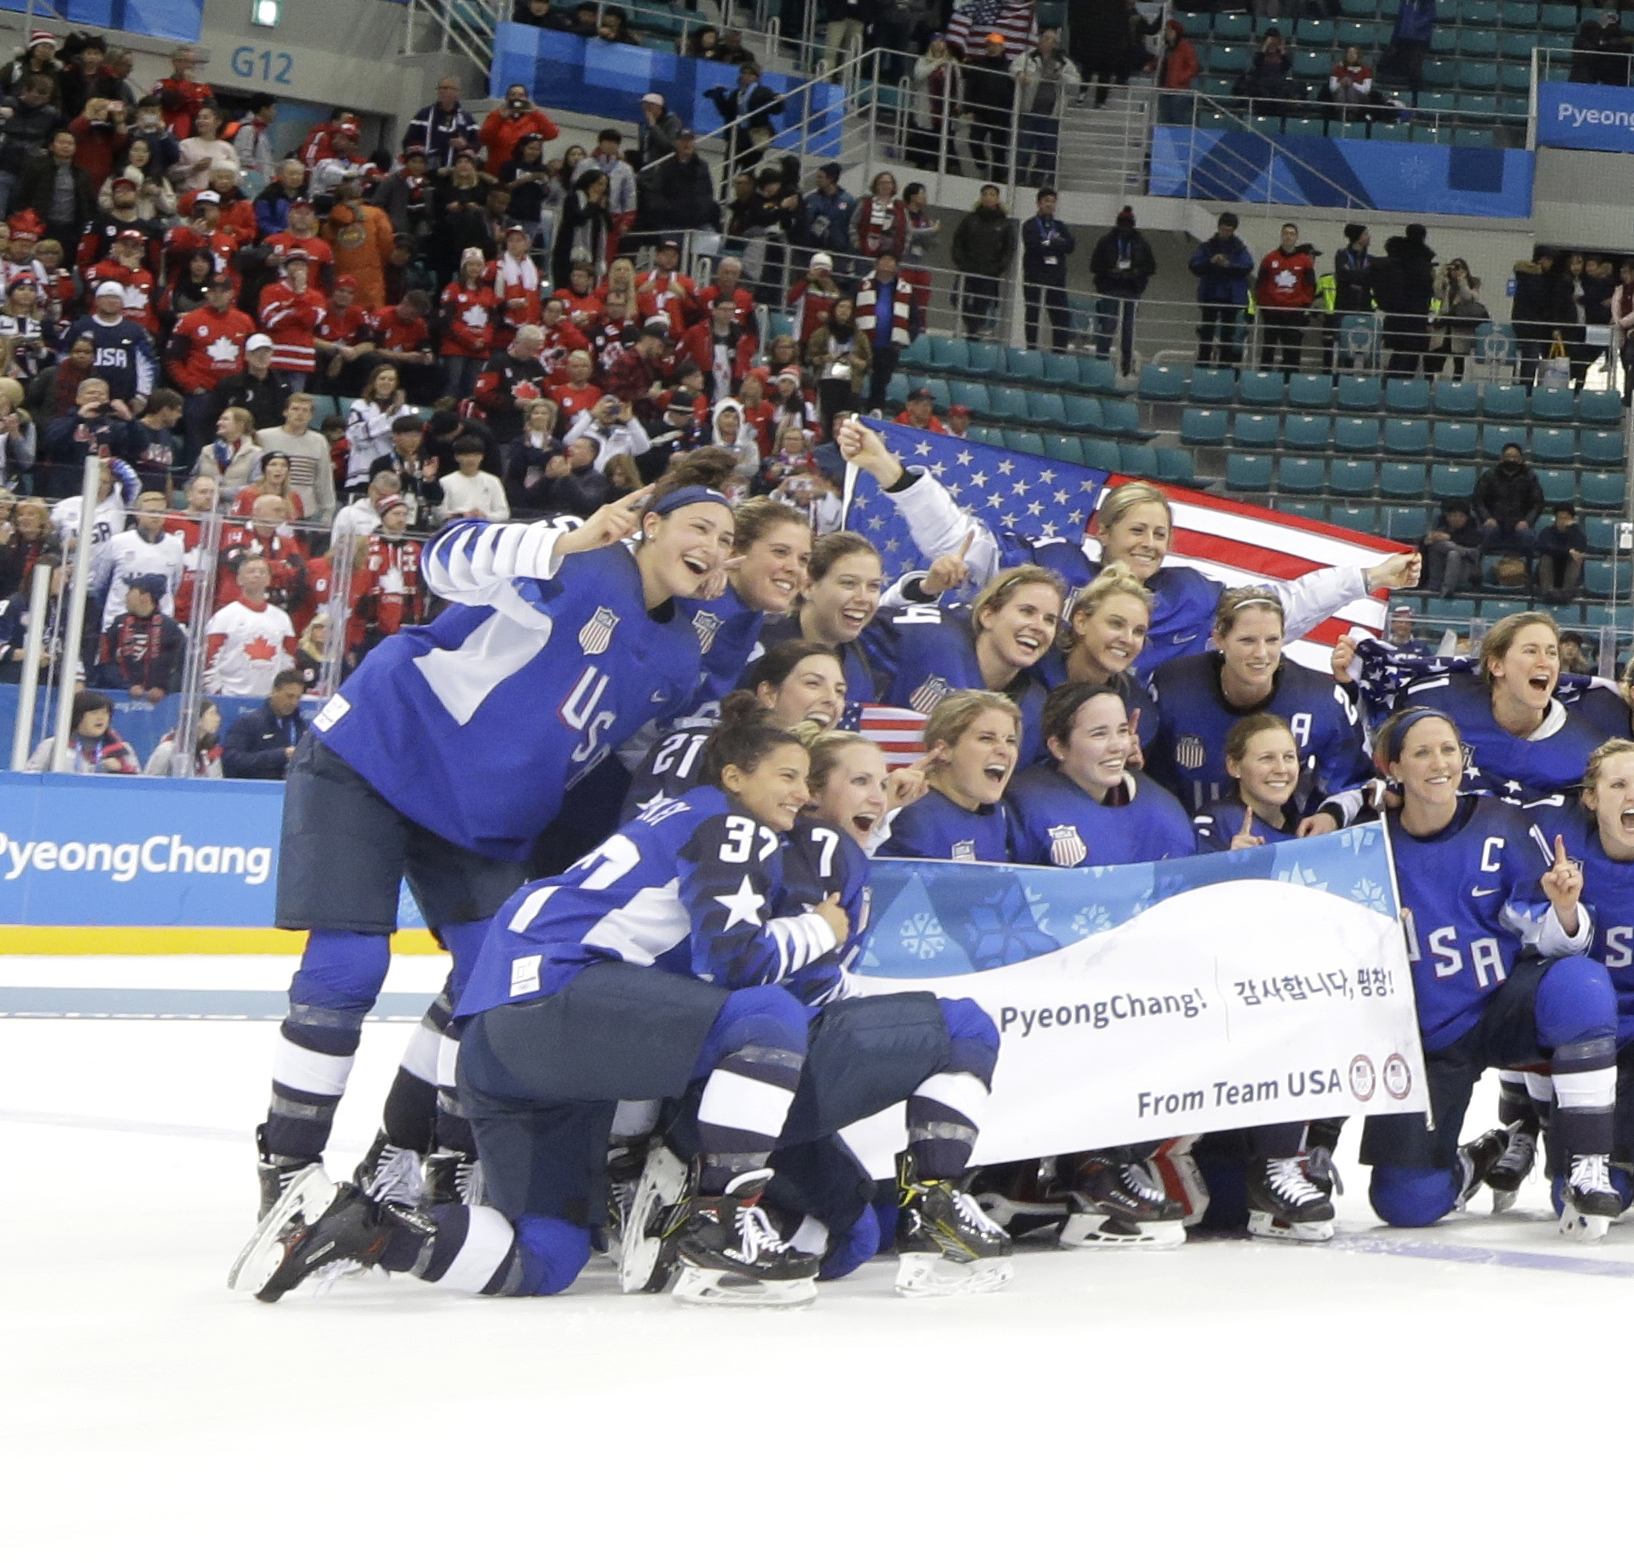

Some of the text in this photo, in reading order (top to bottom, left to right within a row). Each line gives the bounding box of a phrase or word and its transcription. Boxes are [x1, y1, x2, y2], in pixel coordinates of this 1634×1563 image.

[230, 45, 294, 85] G12
[1291, 712, 1313, 748] A
[810, 827, 840, 878] 7
[1480, 836, 1505, 873] C
[1233, 967, 1395, 1007] 감사합니다, 평창!
[1000, 988, 1207, 1037] PyeongChang!
[1137, 1068, 1342, 1118] From Team USA
